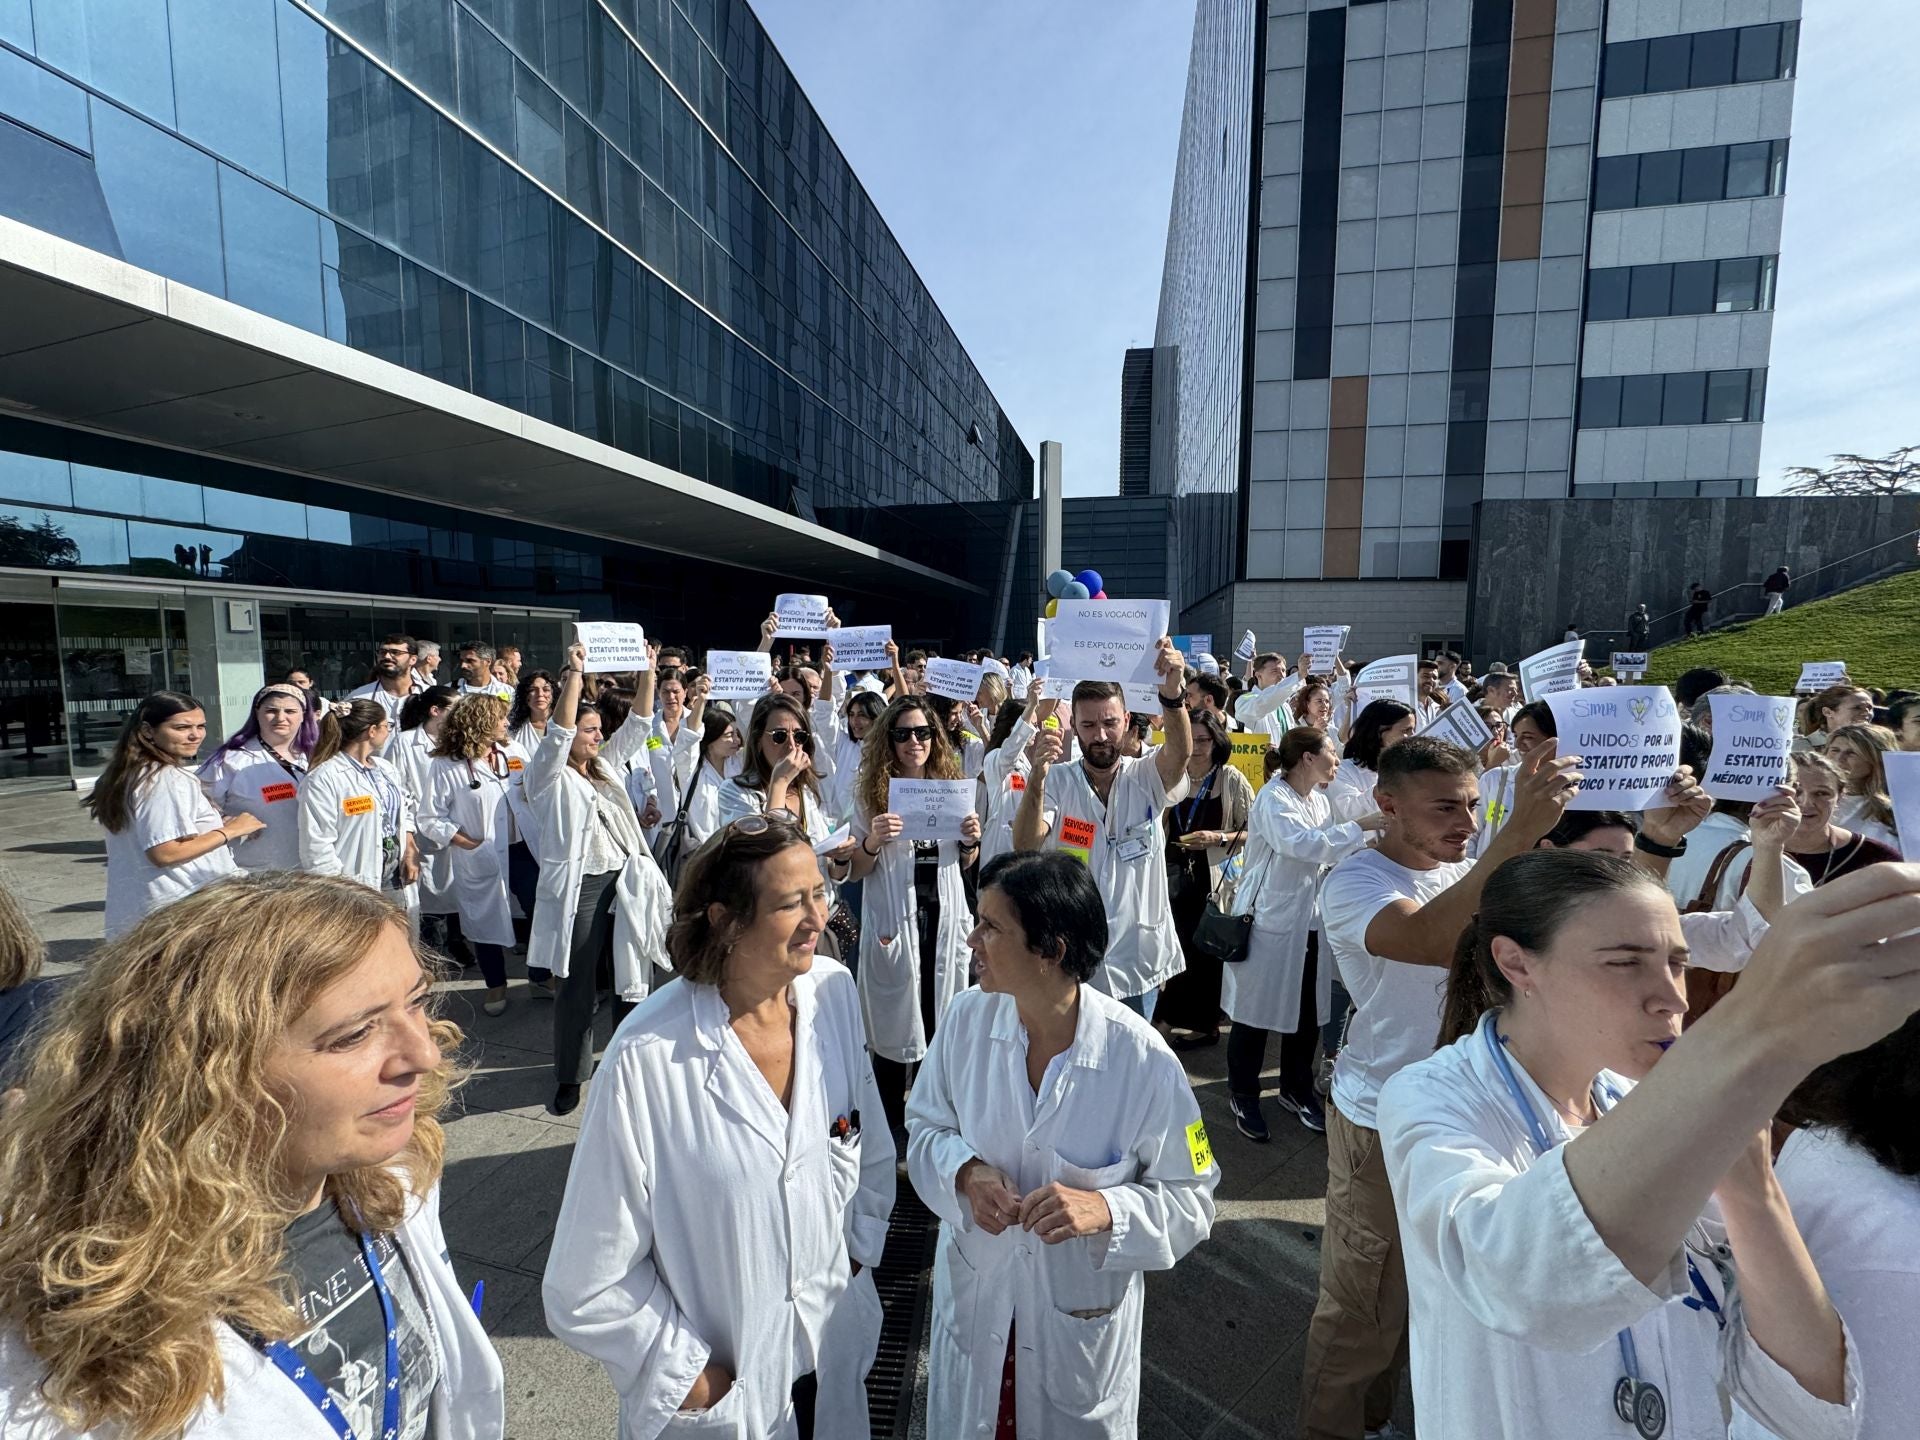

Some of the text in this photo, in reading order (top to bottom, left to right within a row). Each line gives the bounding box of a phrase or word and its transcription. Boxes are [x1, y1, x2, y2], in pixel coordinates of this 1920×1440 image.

[244, 610, 252, 625] 1
[1087, 641, 1144, 651] EXPLOTACIÓN
[1580, 733, 1673, 748] UNIDOS POR UN
[1732, 736, 1783, 750] UNIDOS
[1576, 753, 1674, 769] ESTATUTO PROPIO
[1724, 754, 1783, 768] ESTATUTO
[1609, 779, 1615, 790] Y
[1711, 771, 1753, 784] MÉDICO
[1757, 776, 1764, 786] Y
[262, 784, 293, 794] SERVICIOS
[346, 798, 371, 807] SERVICIOS
[1064, 818, 1094, 833] SERVICIOS
